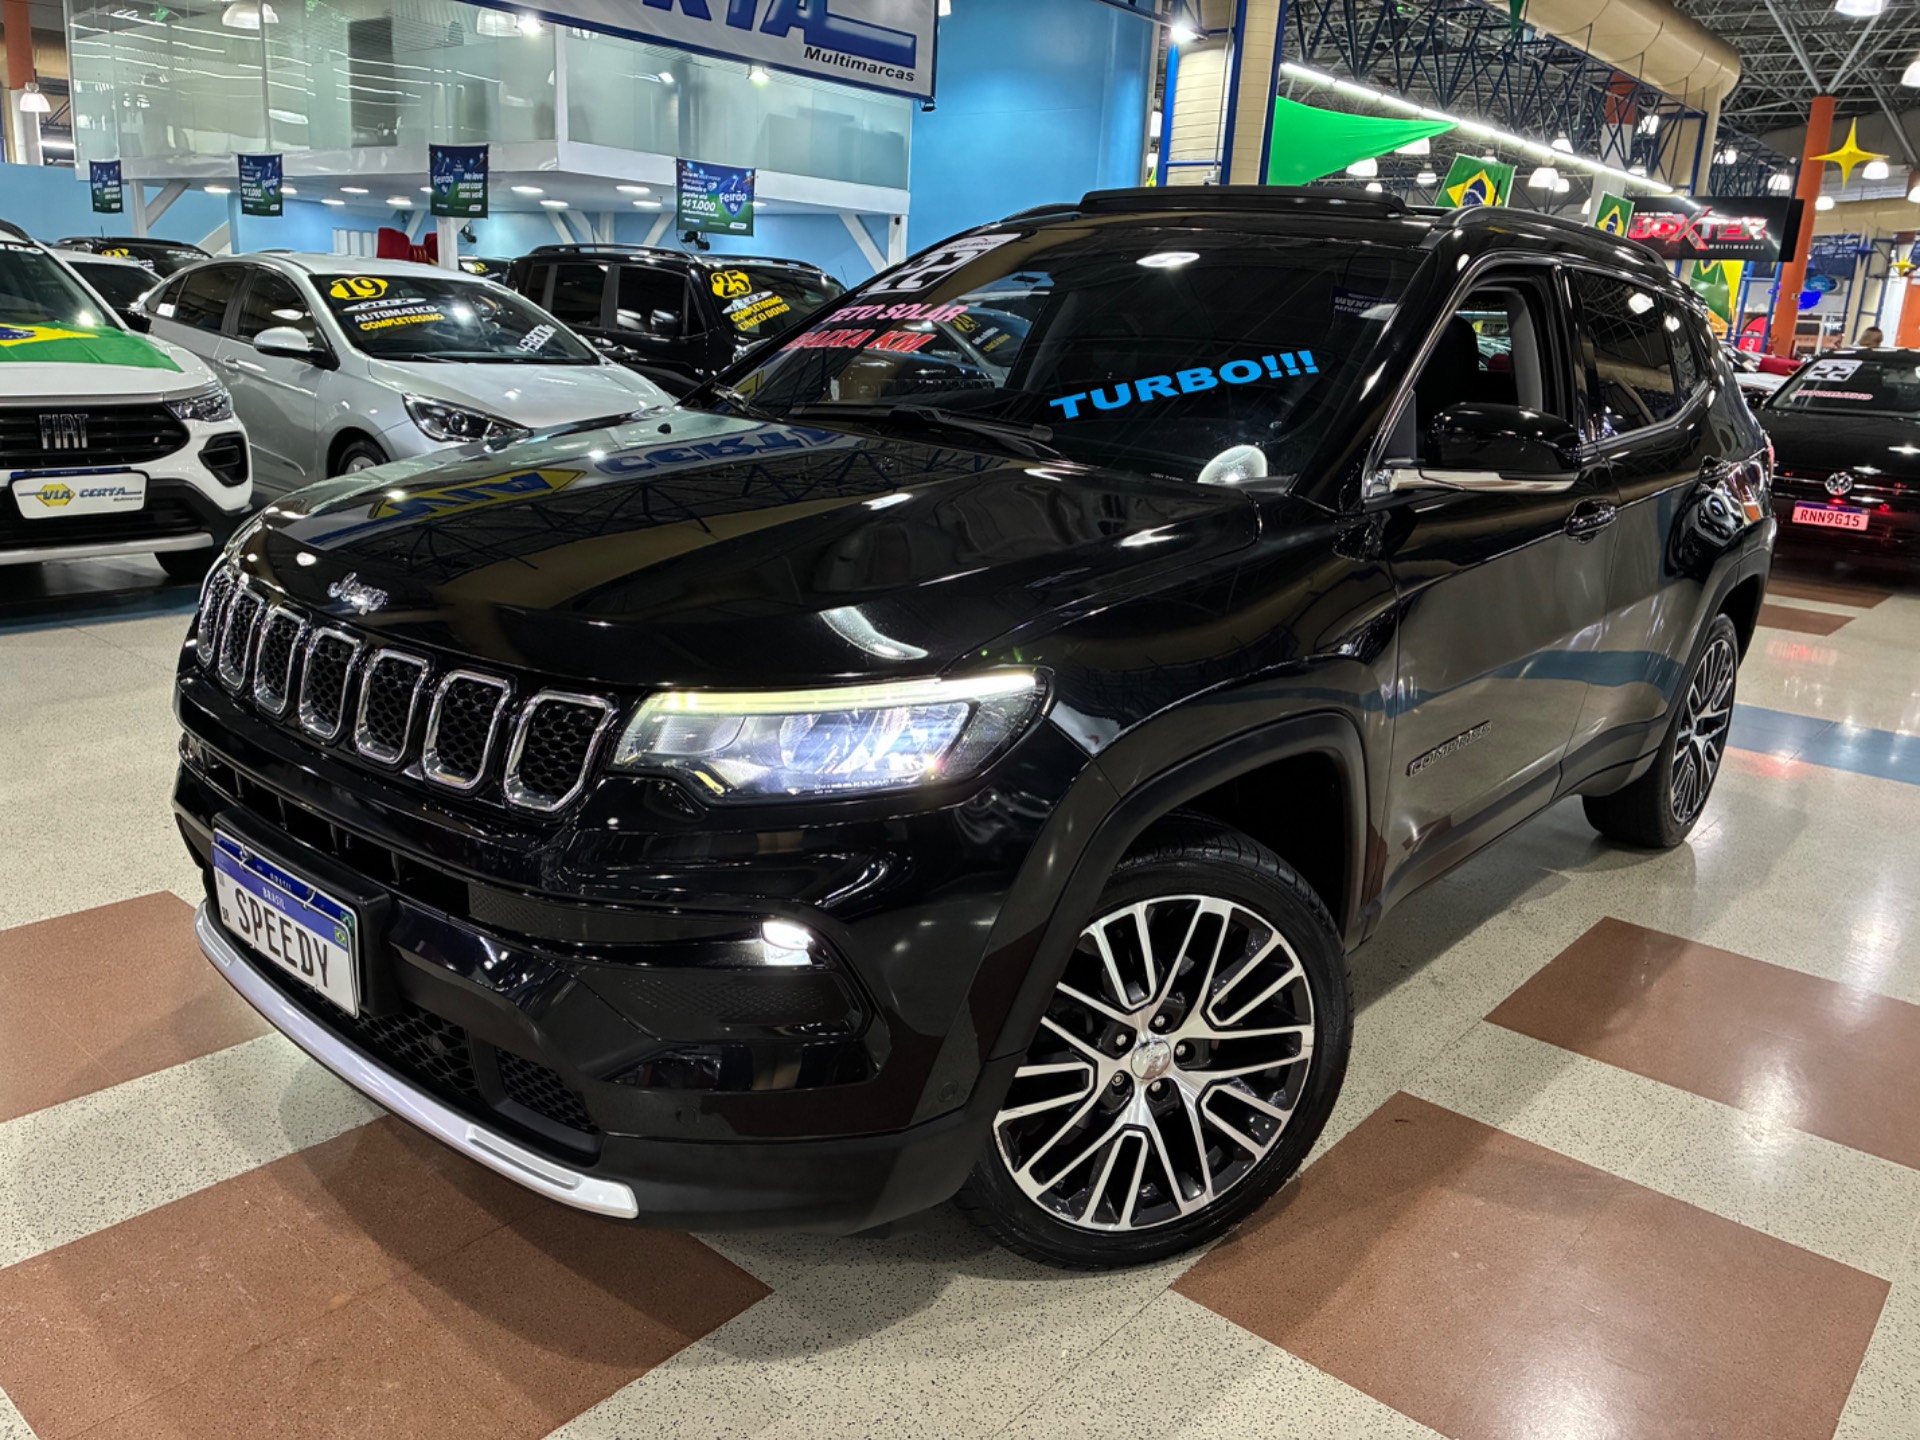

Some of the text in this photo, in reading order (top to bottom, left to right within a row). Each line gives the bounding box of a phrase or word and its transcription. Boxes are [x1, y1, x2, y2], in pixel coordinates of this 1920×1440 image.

[803, 46, 916, 82] Multimarcas
[719, 190, 747, 204] Feirão
[331, 277, 387, 299] 19
[711, 270, 752, 298] 25
[876, 302, 968, 323] SOLAR
[863, 330, 938, 353] KM
[1050, 350, 1319, 419] TURBO!!!
[38, 413, 89, 449] FIAT
[42, 486, 126, 500] VIA CERTA
[261, 886, 287, 911] BRASIL
[235, 887, 329, 989] SPEEDY
